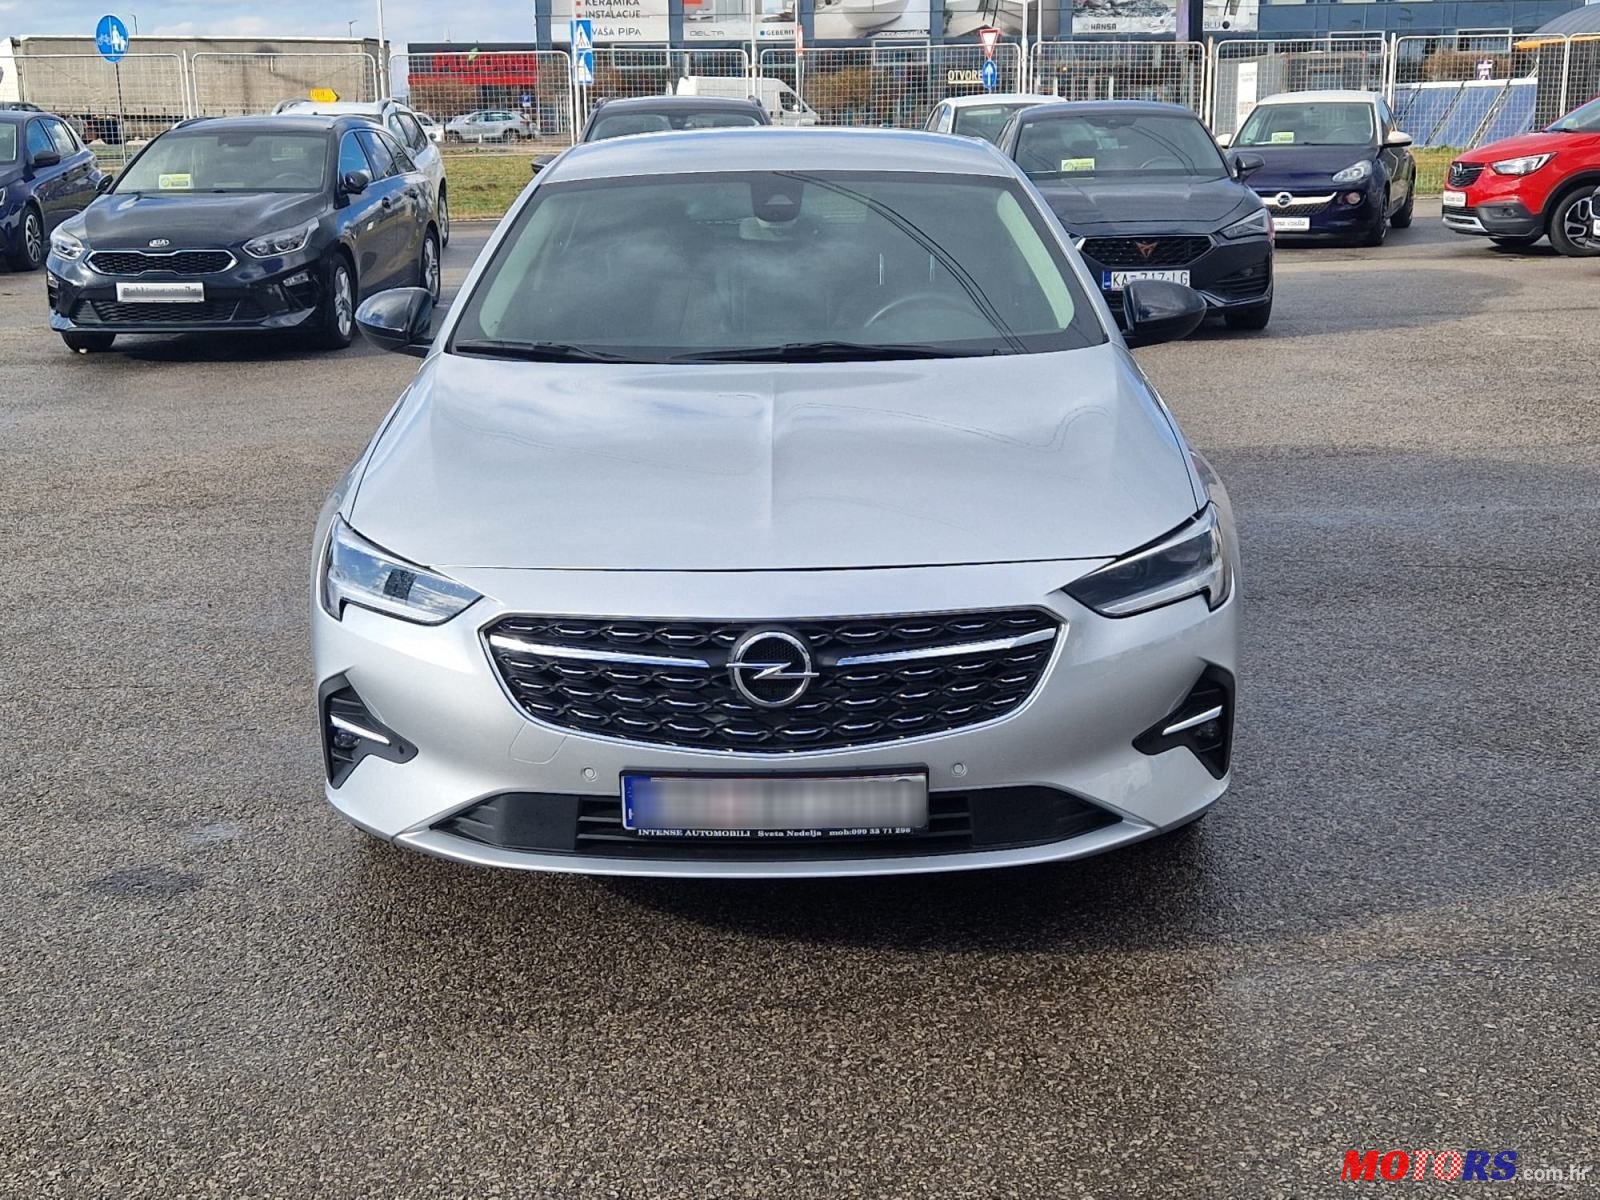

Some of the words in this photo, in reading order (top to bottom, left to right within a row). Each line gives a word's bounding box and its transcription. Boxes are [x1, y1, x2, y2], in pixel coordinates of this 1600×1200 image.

[585, 10, 641, 18] INSTALACIJE
[592, 26, 615, 36] VAŠA
[618, 27, 642, 36] PIPA
[1090, 23, 1117, 31] HANSA
[149, 239, 169, 247] KIA
[786, 829, 822, 838] Nedelja
